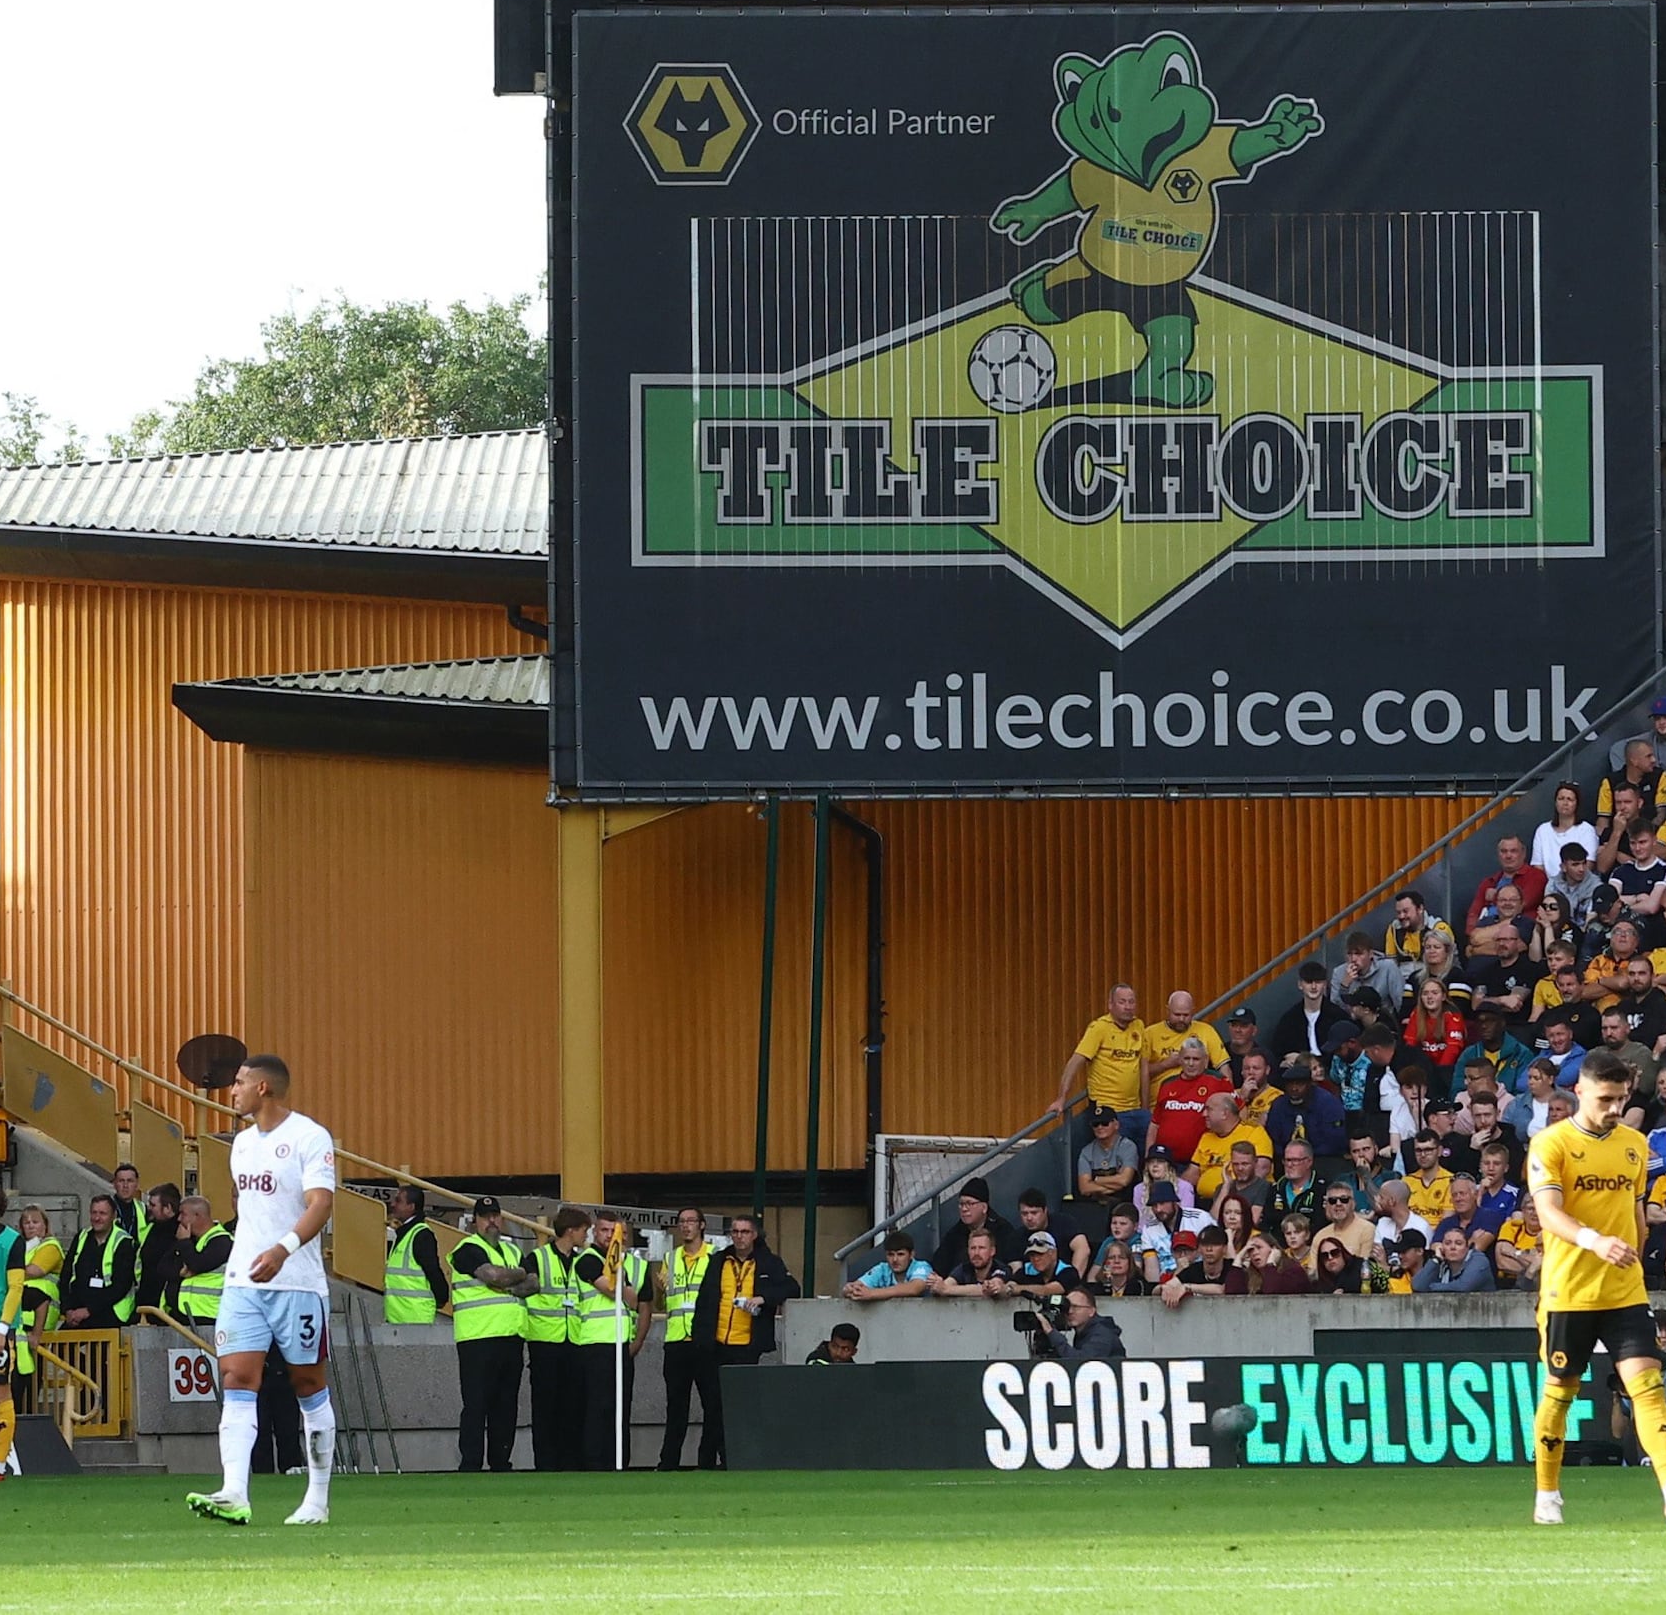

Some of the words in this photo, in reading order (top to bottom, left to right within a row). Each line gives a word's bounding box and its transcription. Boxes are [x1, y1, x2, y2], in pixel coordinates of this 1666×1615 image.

[772, 109, 878, 135] Official
[888, 110, 996, 135] Partner
[1107, 225, 1138, 240] TILE
[1143, 230, 1198, 248] CHOICE
[699, 417, 1000, 526] TILE
[1034, 411, 1533, 524] CHOICE
[639, 664, 1601, 752] www.tilechoice.co.uk
[1164, 1100, 1206, 1113] AstroPay
[238, 1168, 277, 1196] BK8
[299, 1315, 314, 1341] 3
[175, 1355, 212, 1396] 39
[984, 1362, 1210, 1470] SCORE
